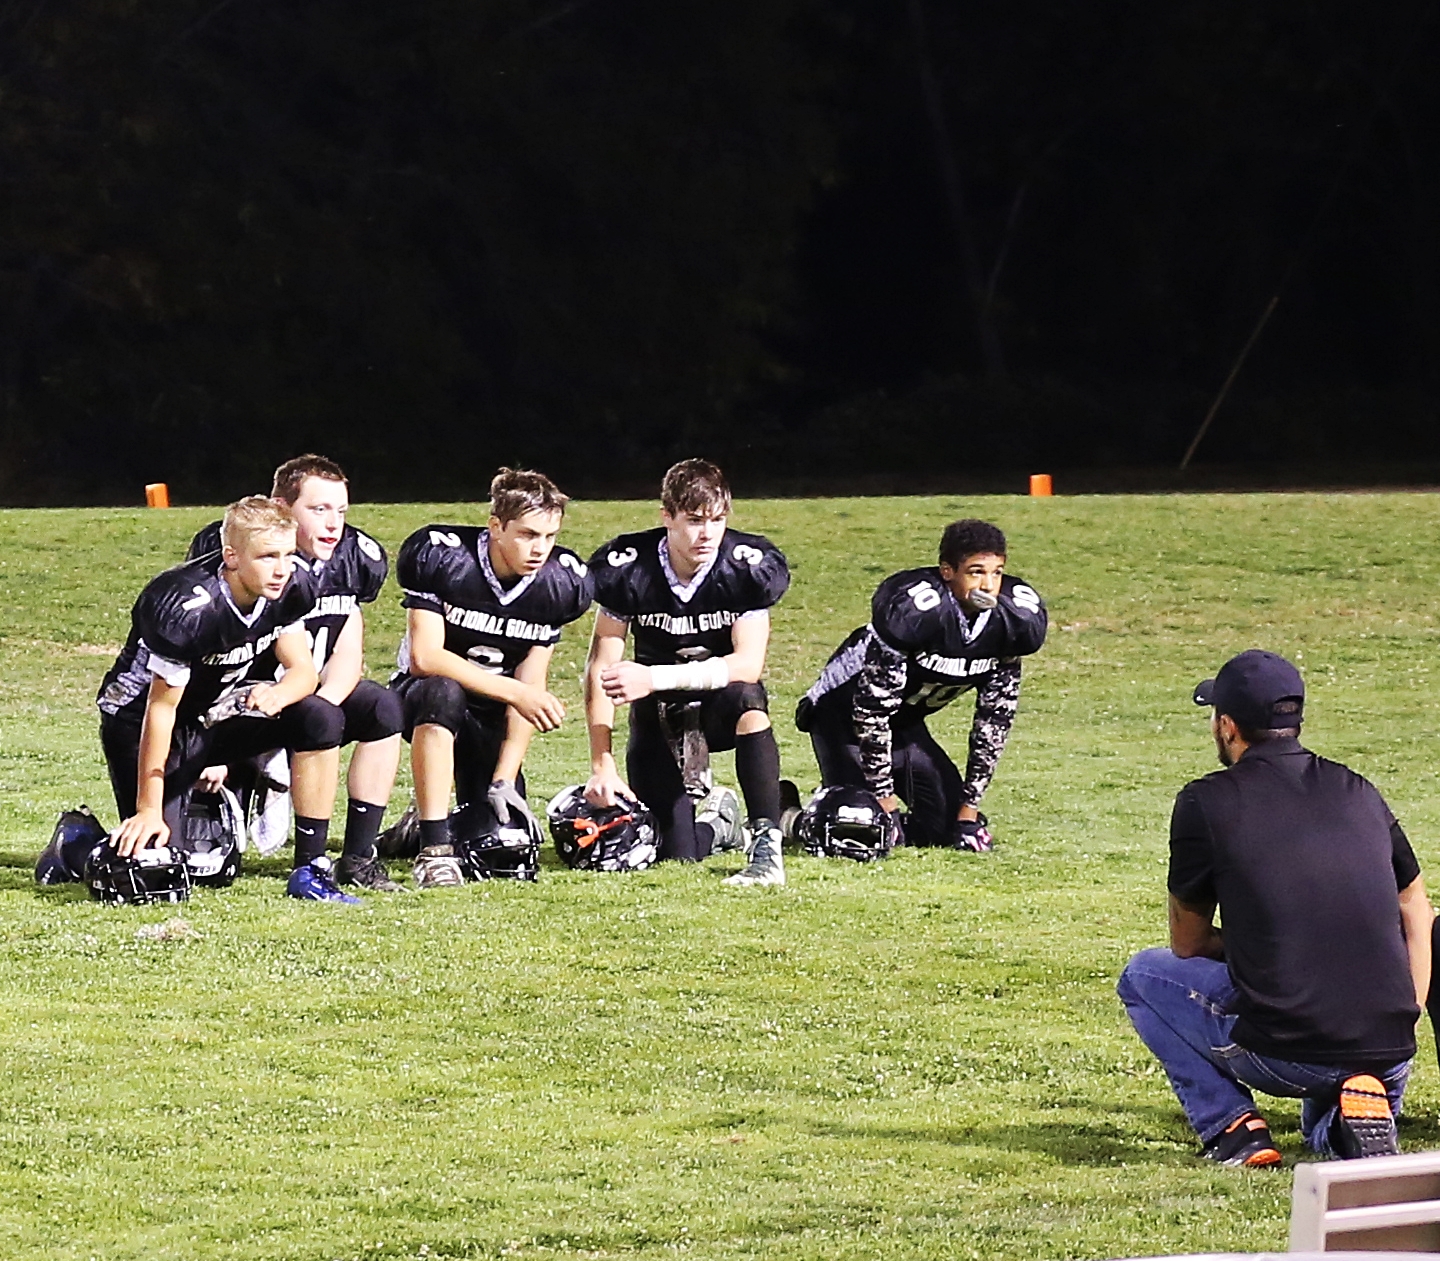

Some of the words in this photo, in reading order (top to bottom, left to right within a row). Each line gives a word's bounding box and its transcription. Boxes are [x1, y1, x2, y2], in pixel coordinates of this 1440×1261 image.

[558, 553, 589, 579] 2
[607, 546, 639, 567] 3
[732, 544, 764, 565] 3
[907, 580, 942, 612] 10
[1012, 584, 1041, 615] 10
[443, 601, 505, 635] NATIONAL
[637, 611, 699, 635] NATIONAL
